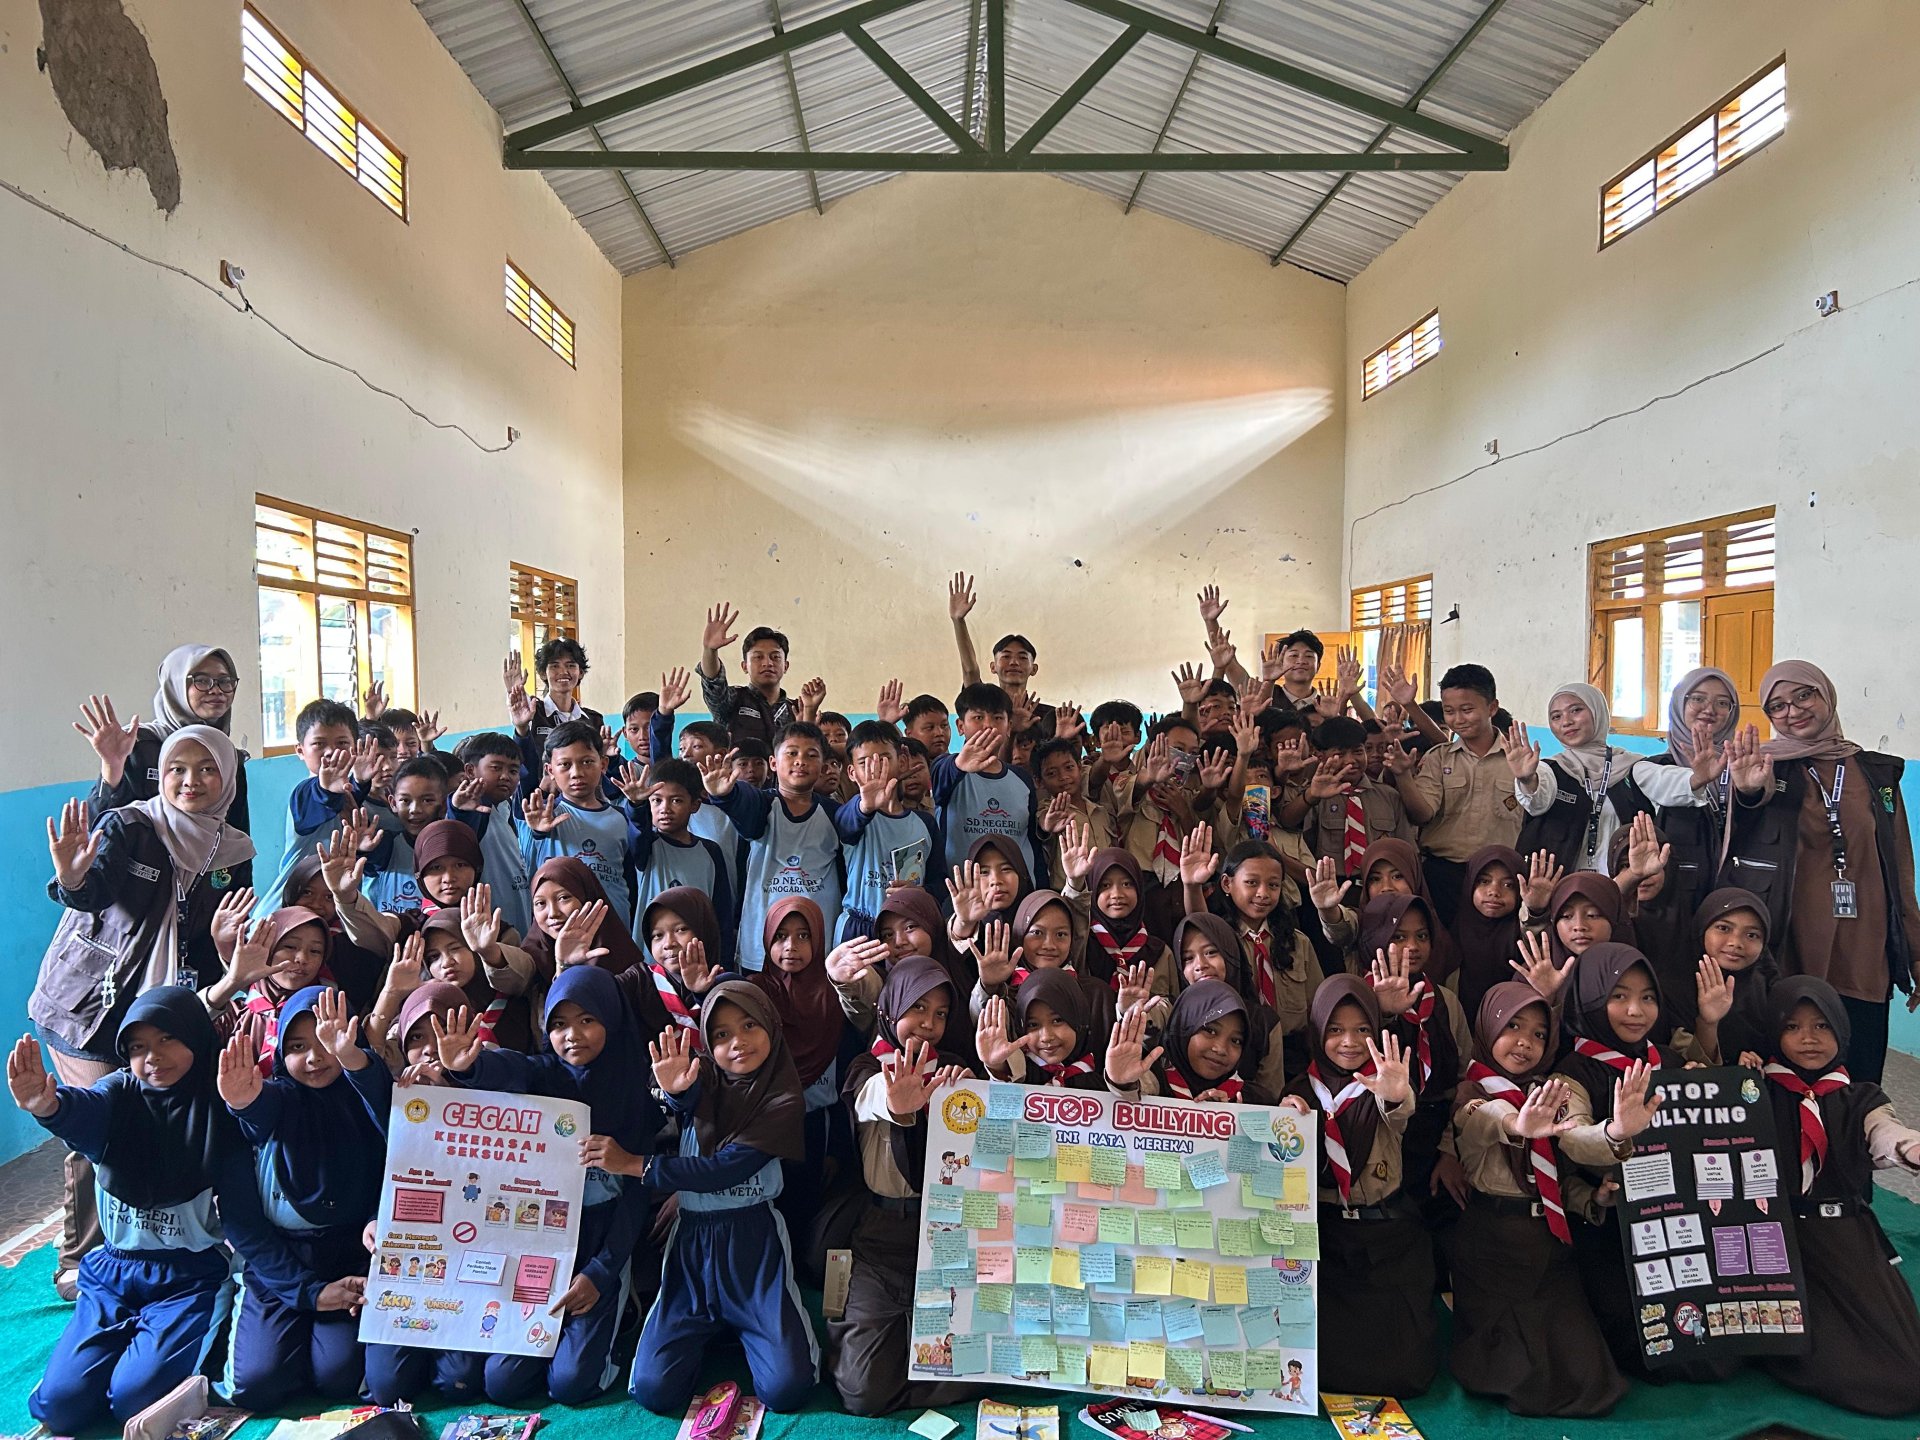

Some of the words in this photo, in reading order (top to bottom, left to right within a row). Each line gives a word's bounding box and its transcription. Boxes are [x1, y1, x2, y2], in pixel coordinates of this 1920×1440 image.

[966, 817, 980, 826] SD
[982, 820, 1016, 829] NEGERI
[1654, 1082, 1720, 1102] STOP
[443, 1102, 542, 1135] CEGAH
[1024, 1093, 1104, 1126] STOP
[1112, 1100, 1235, 1141] BULLYING
[1647, 1105, 1747, 1128] ULLYING
[434, 1131, 546, 1153] KEKERASAN
[1056, 1130, 1080, 1145] INI
[1088, 1133, 1126, 1148] KATA
[1134, 1136, 1194, 1153] MEREKA!
[447, 1146, 528, 1163] SEKSUAL
[729, 1186, 765, 1197] WETAN
[382, 1294, 413, 1308] KKN
[401, 1317, 431, 1331] 2026
